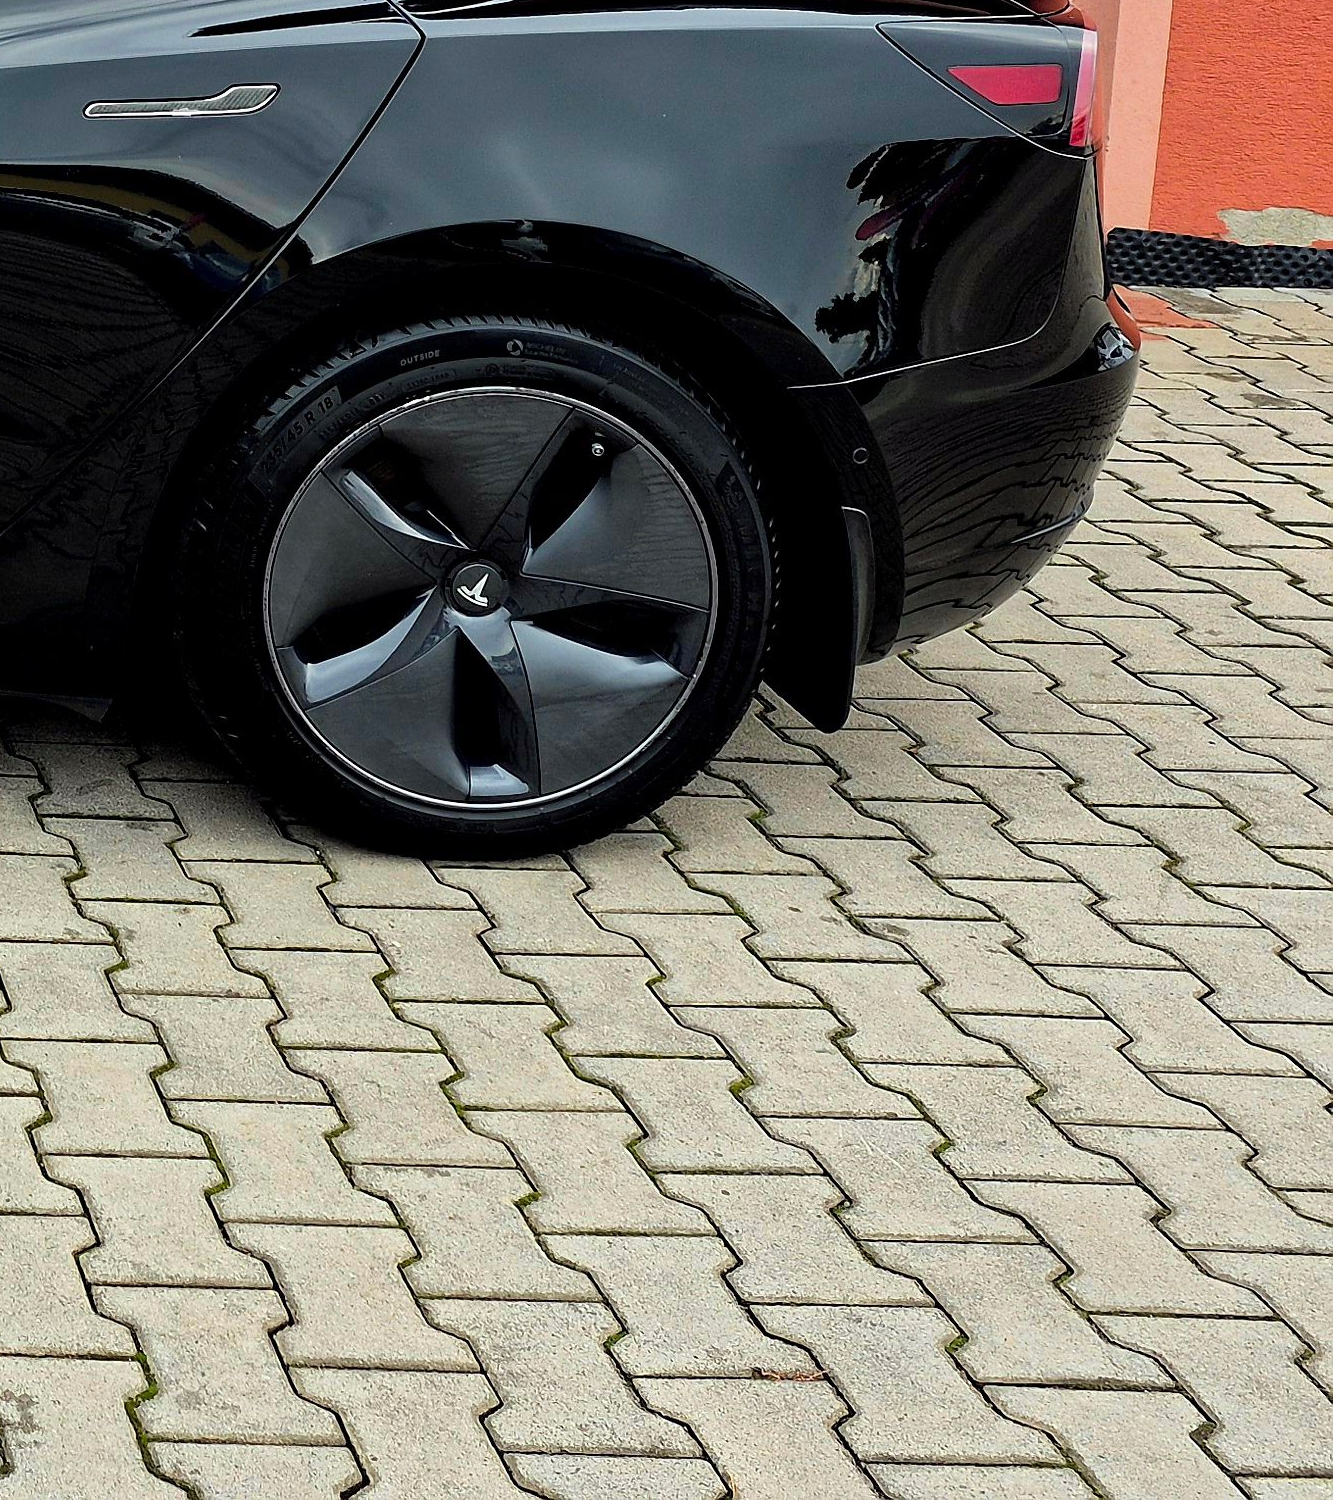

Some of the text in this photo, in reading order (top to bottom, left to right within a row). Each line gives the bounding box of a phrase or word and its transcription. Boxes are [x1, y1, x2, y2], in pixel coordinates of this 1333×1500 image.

[399, 348, 441, 367] OUTSIDE
[303, 410, 317, 426] R
[317, 396, 334, 414] 18
